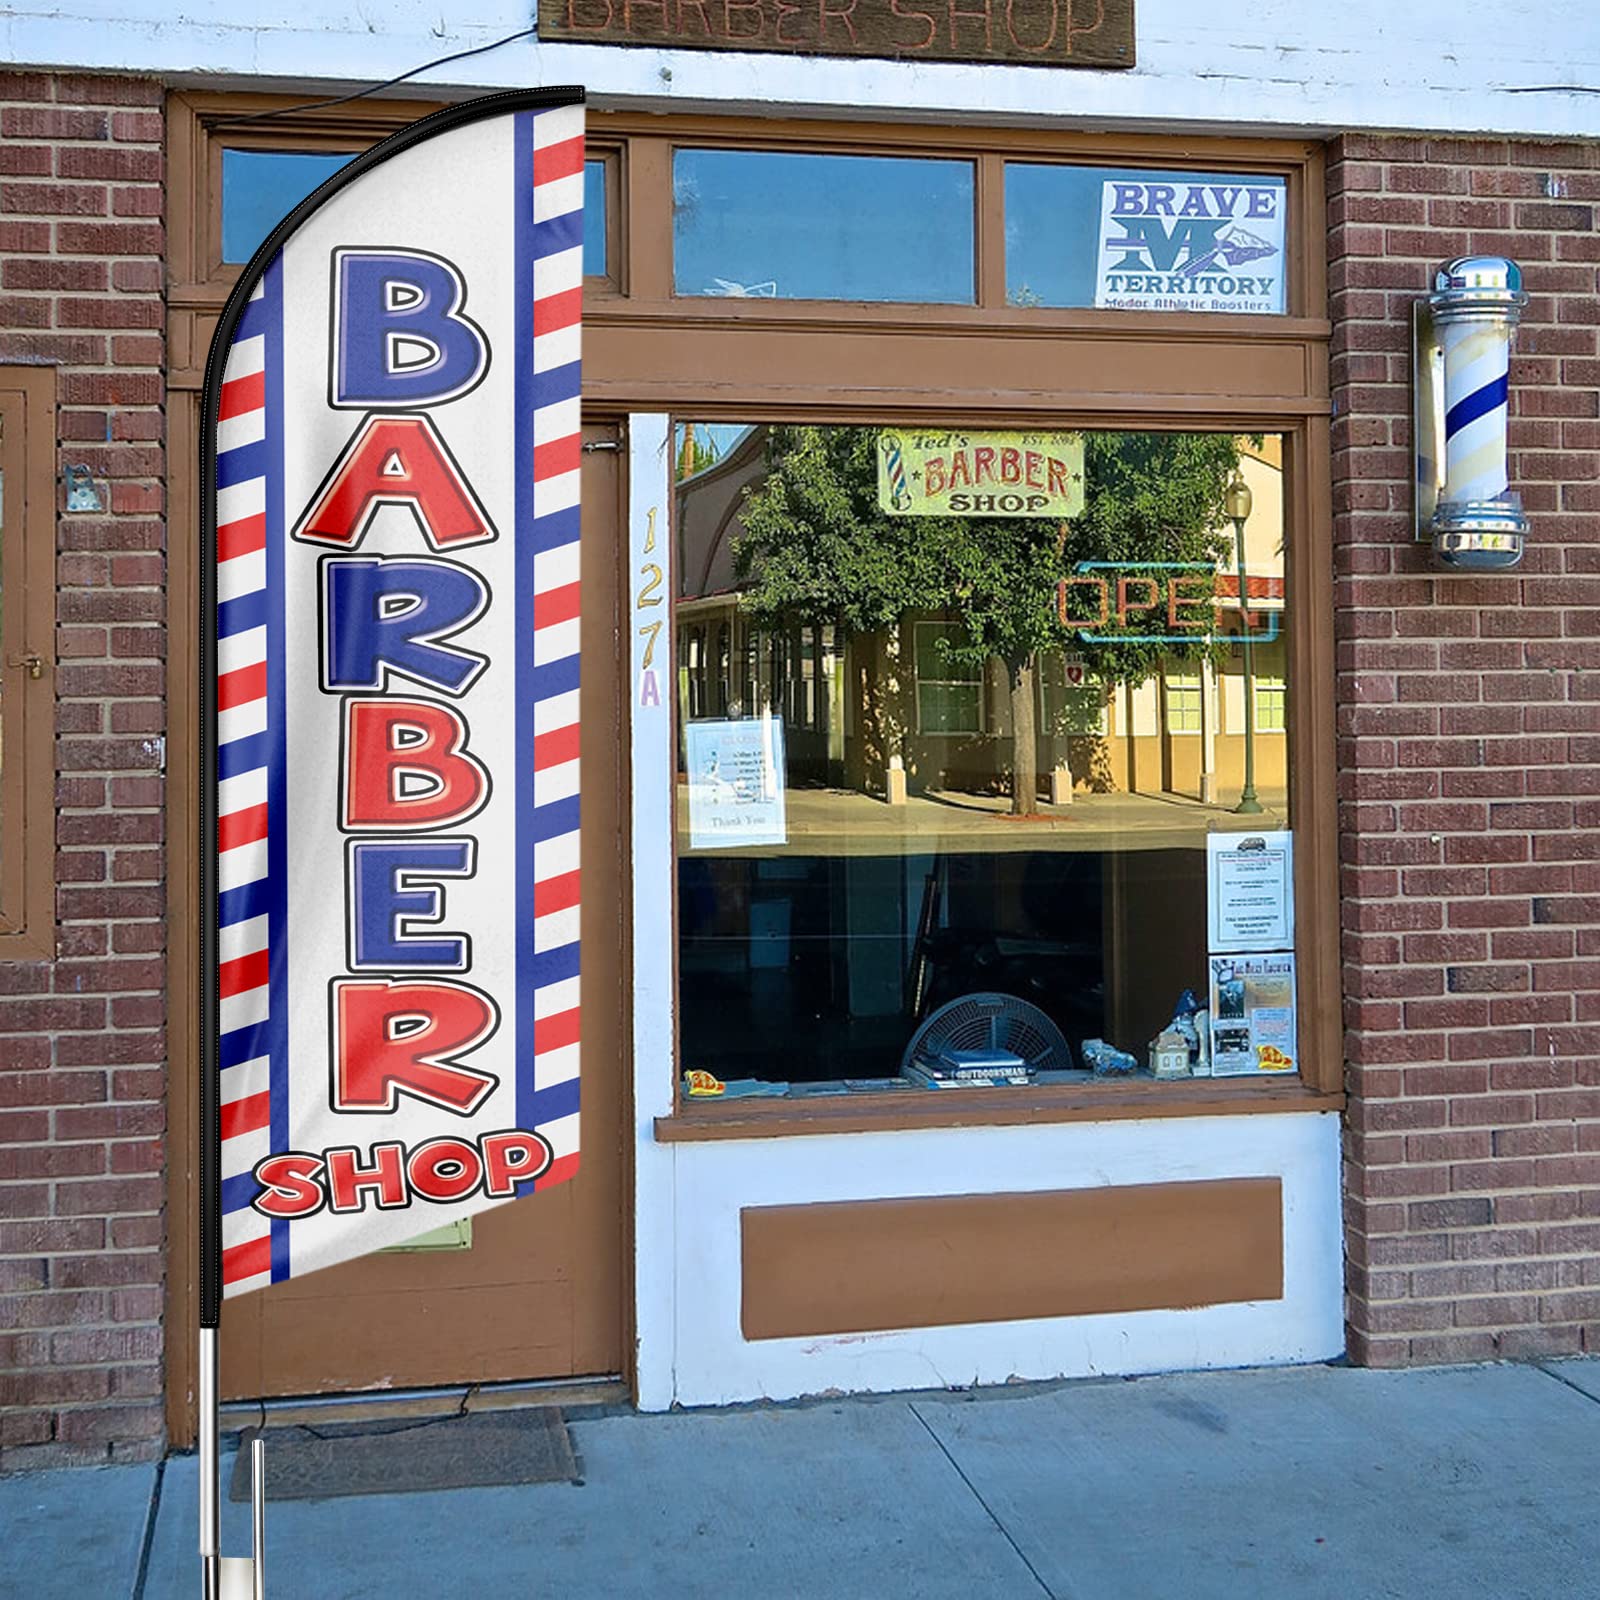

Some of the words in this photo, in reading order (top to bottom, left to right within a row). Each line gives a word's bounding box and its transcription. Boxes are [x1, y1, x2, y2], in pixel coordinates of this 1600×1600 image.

[892, 0, 1105, 55] SHOP
[1111, 184, 1277, 219] BRAVE
[1105, 274, 1275, 296] TERRITORY
[1211, 299, 1271, 311] Boosters
[912, 433, 970, 450] Ted's
[924, 446, 1069, 498] BARBER
[948, 493, 1050, 513] SHOP
[291, 245, 500, 1117] BARBER
[251, 1129, 554, 1220] SHOP
